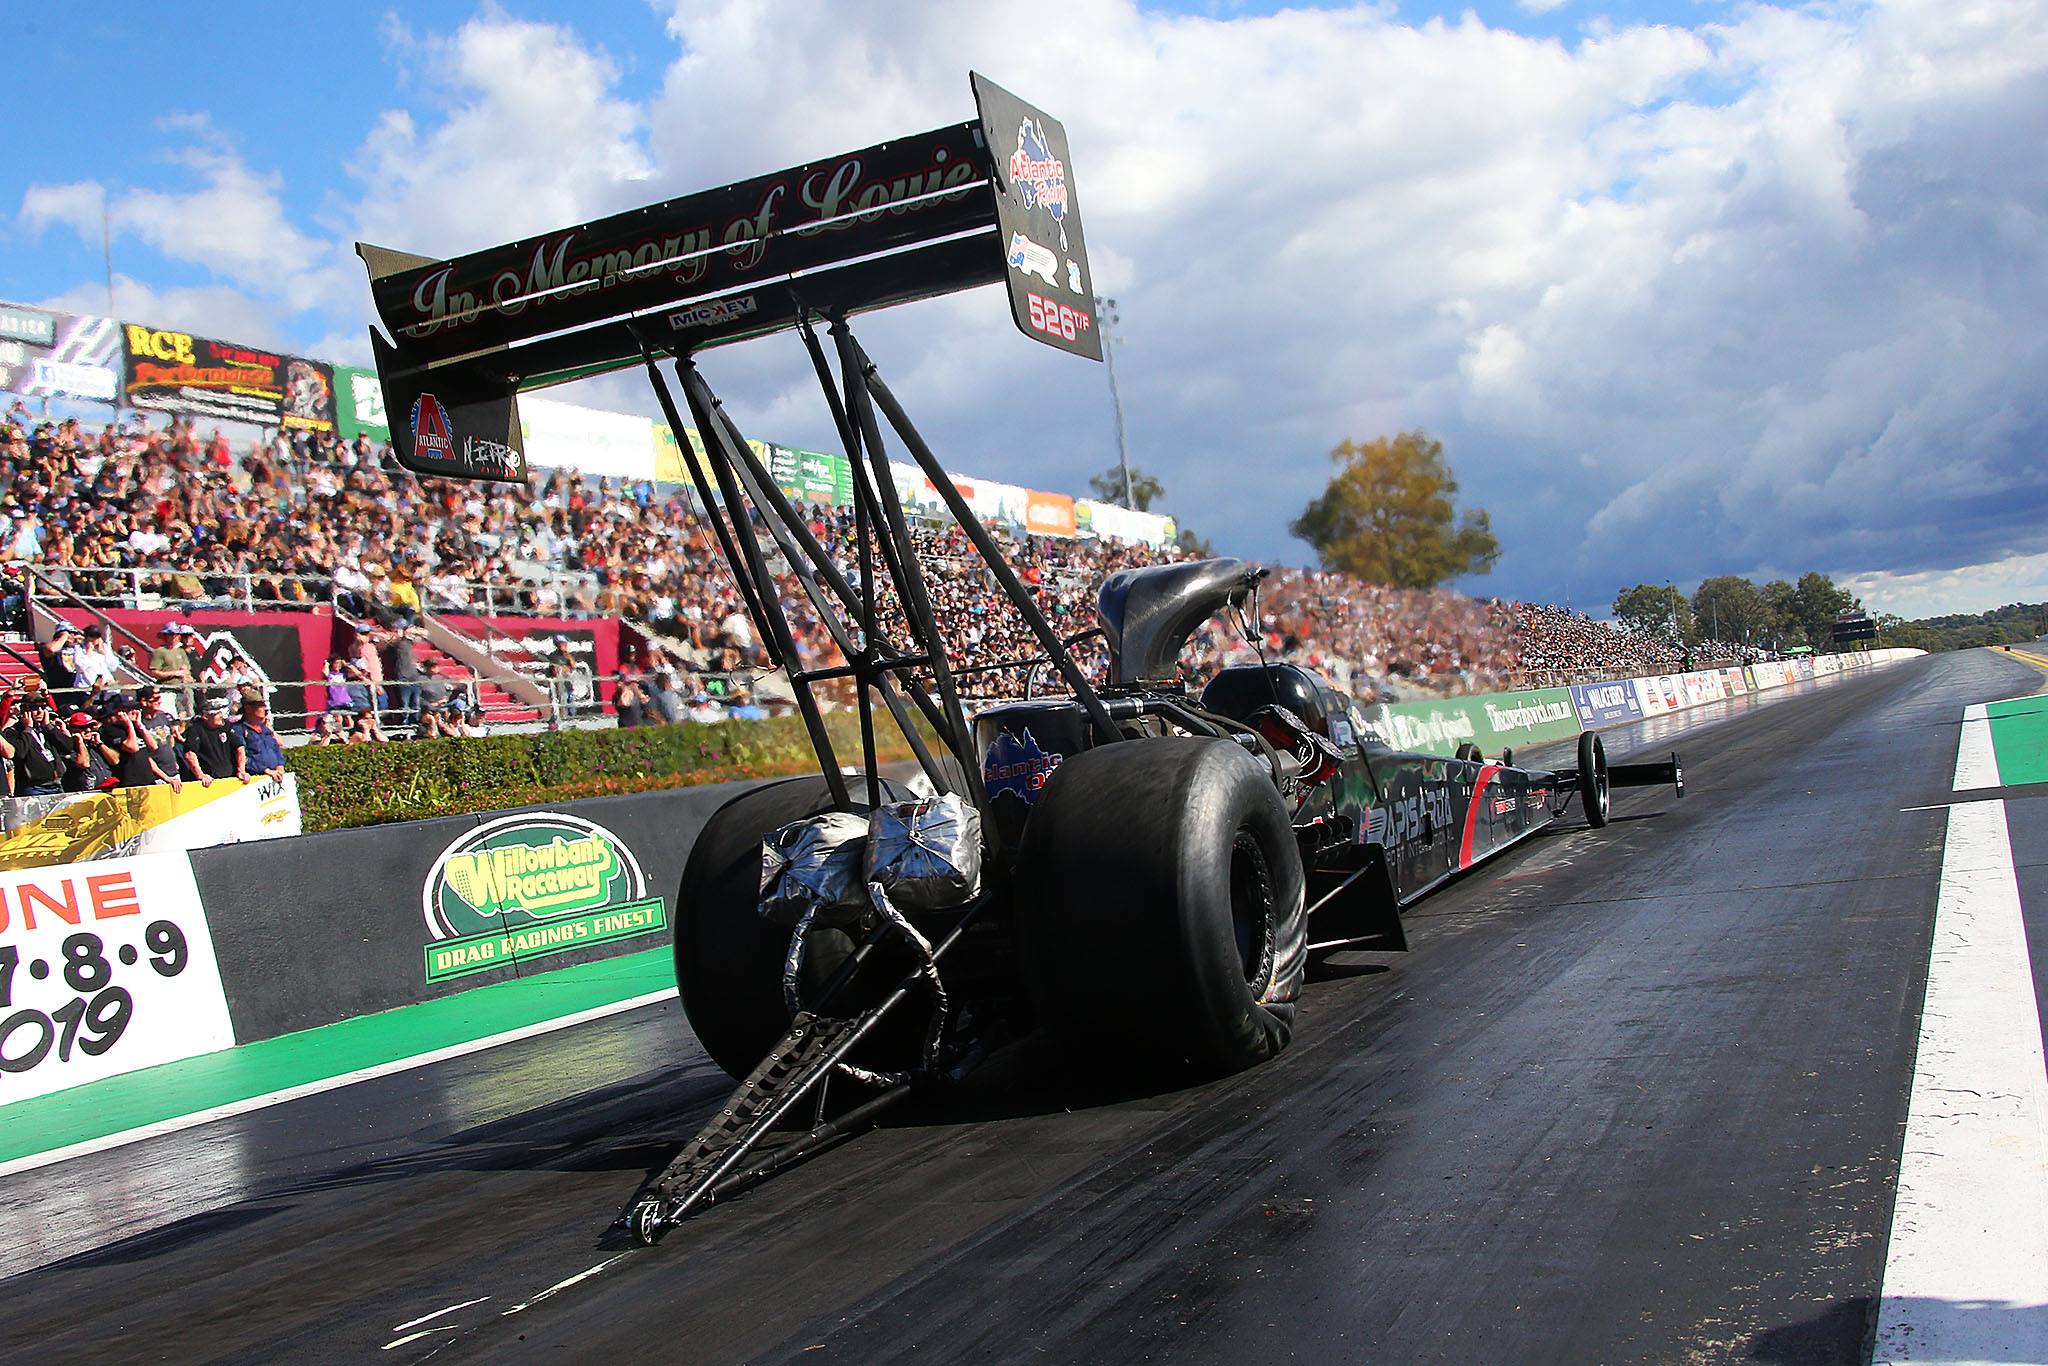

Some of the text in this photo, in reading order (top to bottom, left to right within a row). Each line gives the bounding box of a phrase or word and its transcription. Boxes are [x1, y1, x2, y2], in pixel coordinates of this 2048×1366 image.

[1010, 150, 1064, 184] Atlantic
[405, 148, 978, 338] In Memory of Louie
[672, 298, 751, 326] MICKEY
[1027, 292, 1076, 342] 526
[127, 324, 196, 365] RCE
[419, 434, 449, 449] ATLANTIC
[445, 832, 613, 908] Willowbank
[505, 863, 602, 910] Raceway
[436, 908, 655, 971] DRAG RACING'S FINEST
[0, 985, 133, 1074] 019
